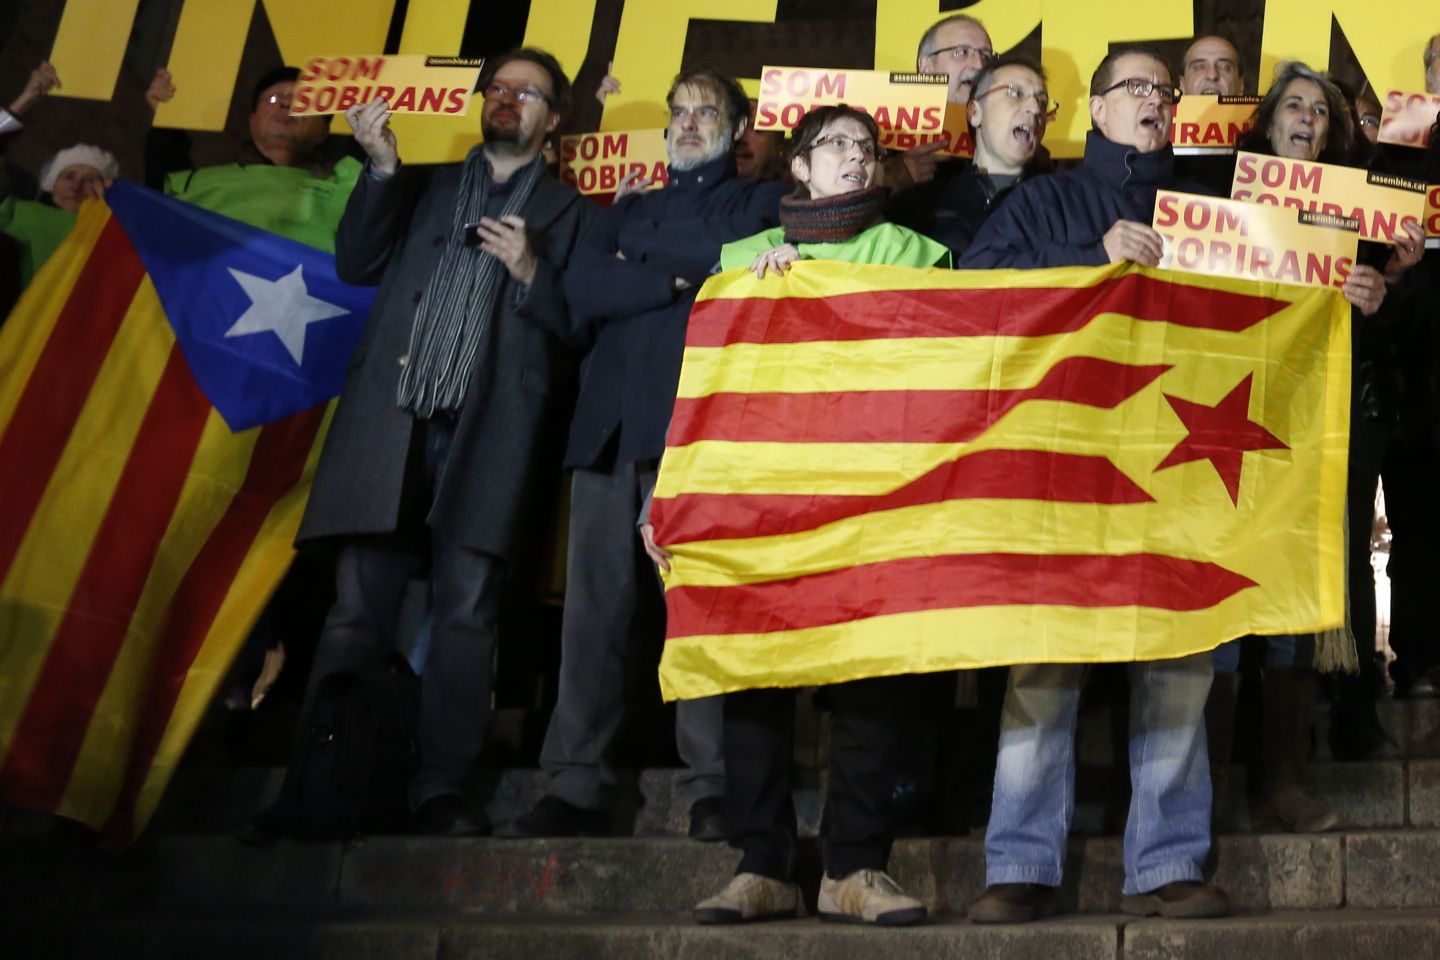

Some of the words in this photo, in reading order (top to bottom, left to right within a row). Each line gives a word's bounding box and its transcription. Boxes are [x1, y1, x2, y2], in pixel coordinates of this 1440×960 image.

[300, 57, 386, 82] SOM
[893, 73, 948, 84] assemblea.cat
[762, 68, 847, 99] SOM
[292, 85, 468, 113] SOBIRANS
[757, 103, 942, 131] SOANS
[562, 134, 628, 161] SOM
[1236, 155, 1323, 194] SOM
[1371, 173, 1427, 192] assemblea.cat
[1156, 195, 1249, 236] SOM
[1302, 213, 1360, 230] assemblea.cat
